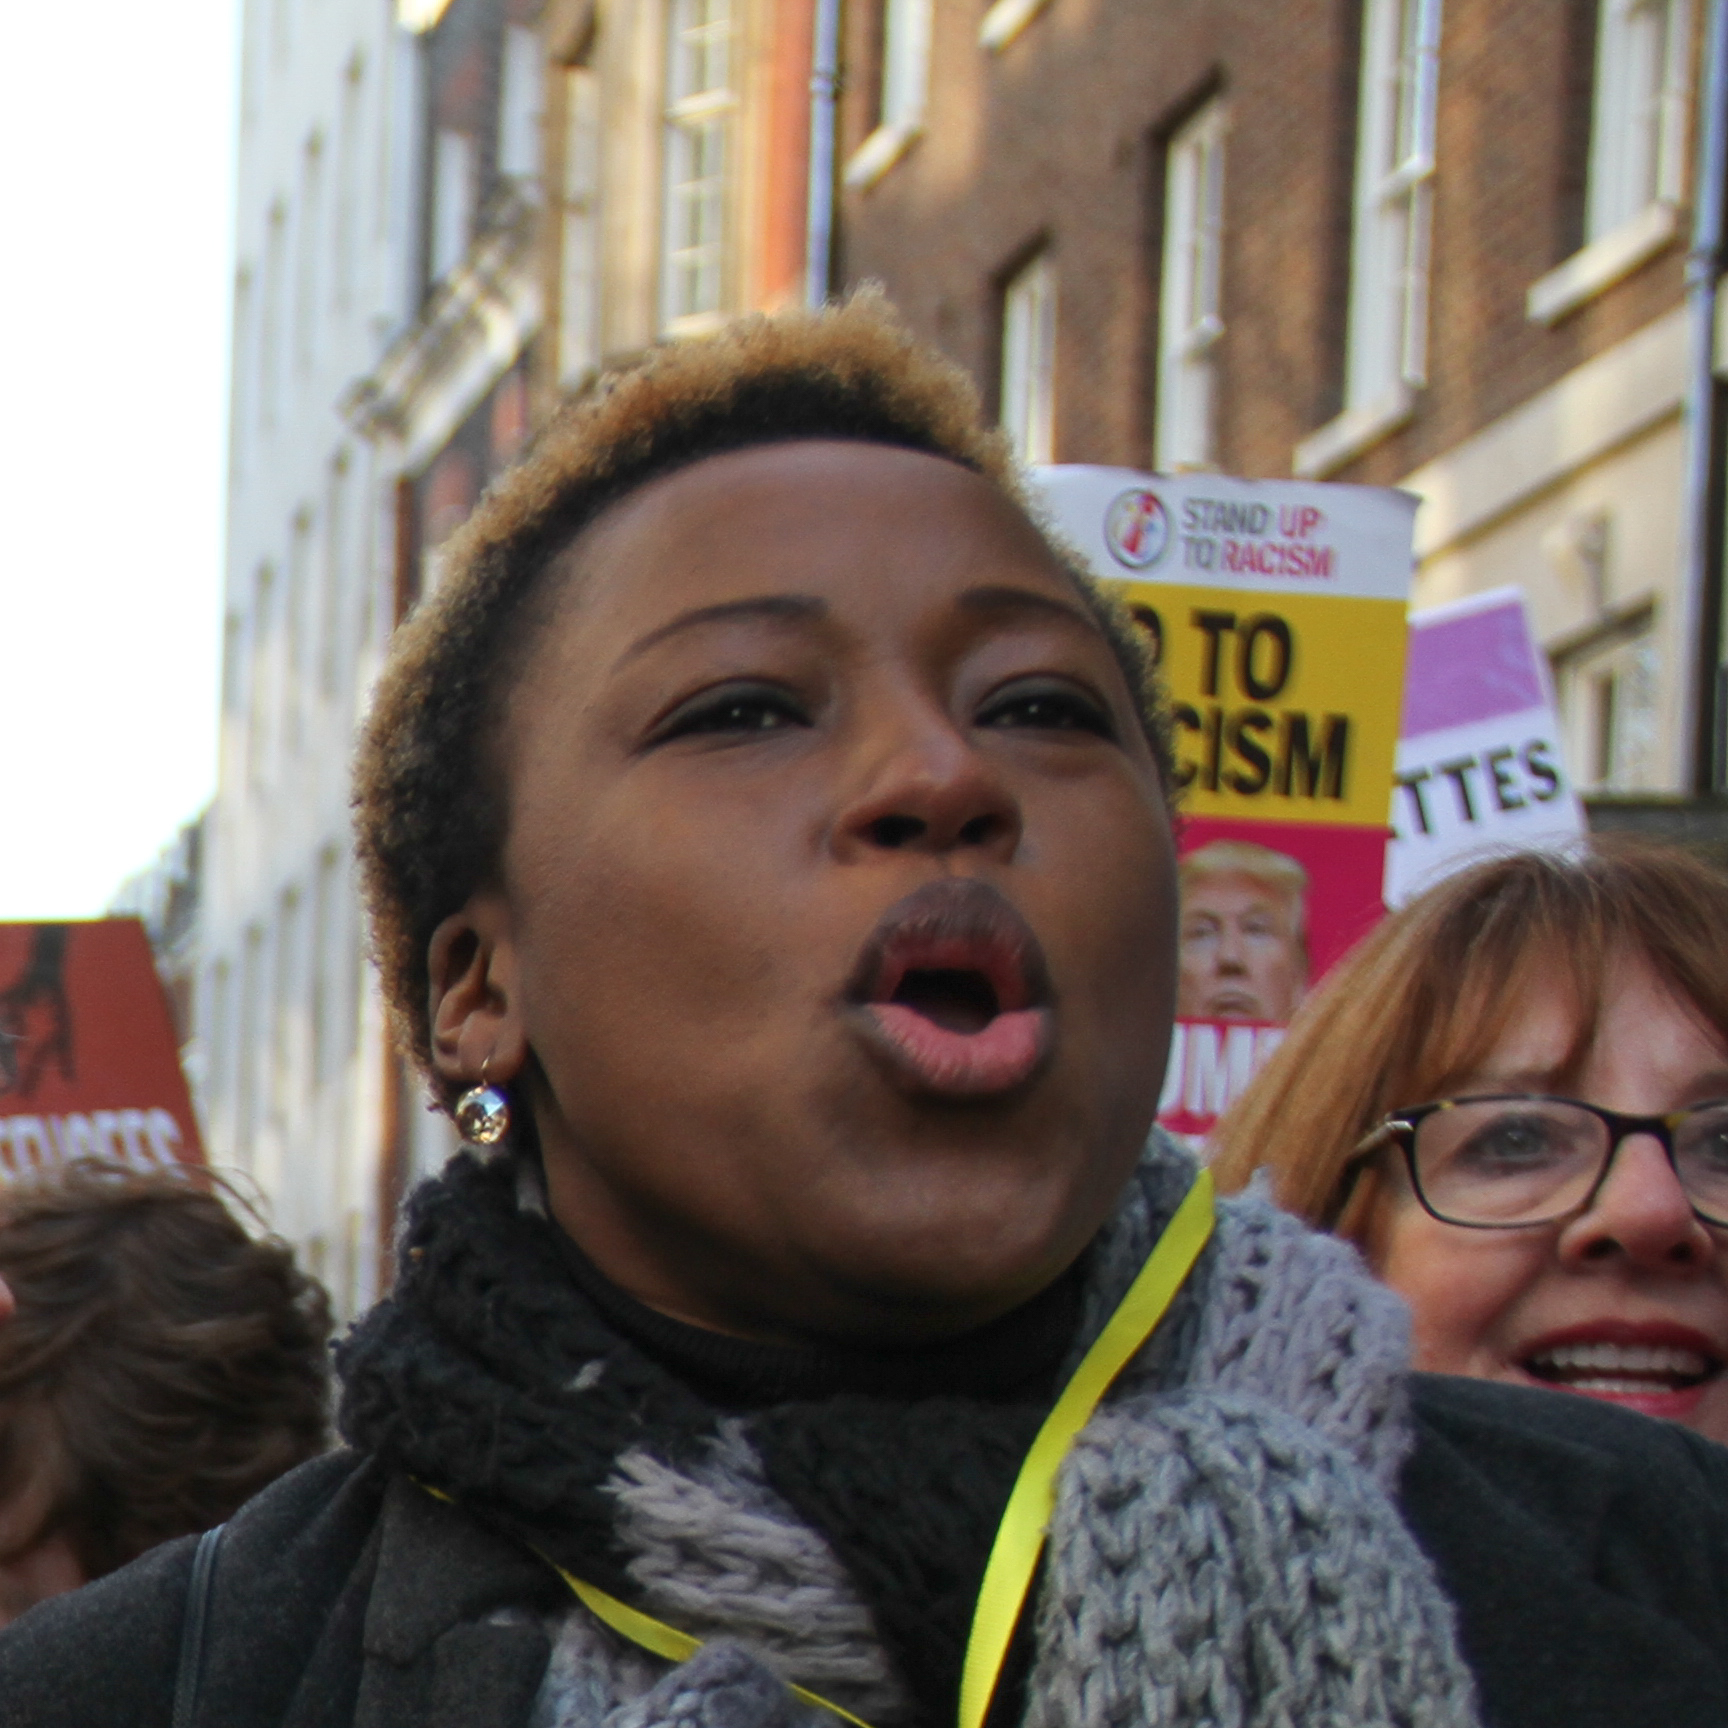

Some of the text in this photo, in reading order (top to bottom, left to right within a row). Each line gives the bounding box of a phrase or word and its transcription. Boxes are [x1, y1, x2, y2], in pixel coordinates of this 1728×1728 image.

[1183, 498, 1322, 538] STAND UP
[1183, 536, 1336, 578] TO RACISM
[1190, 607, 1293, 702] TO
[1392, 739, 1562, 840] TTES
